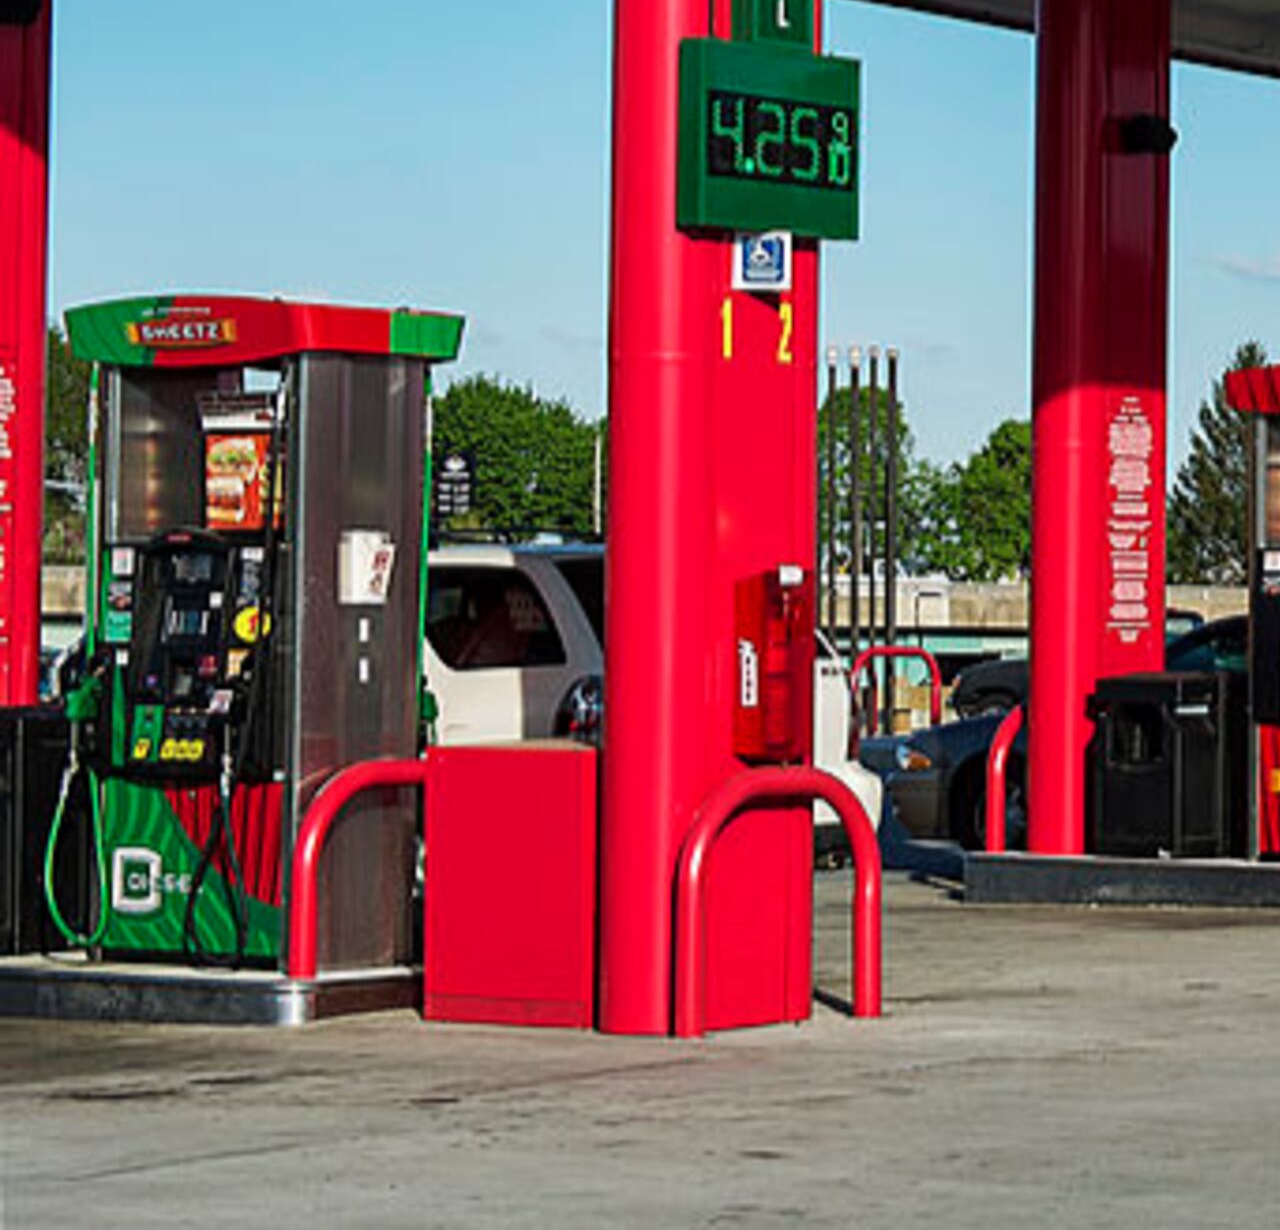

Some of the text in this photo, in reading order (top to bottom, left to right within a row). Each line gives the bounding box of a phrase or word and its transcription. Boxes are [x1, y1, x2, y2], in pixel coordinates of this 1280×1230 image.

[141, 323, 219, 341] SHEETZ
[721, 297, 792, 362] 1 2
